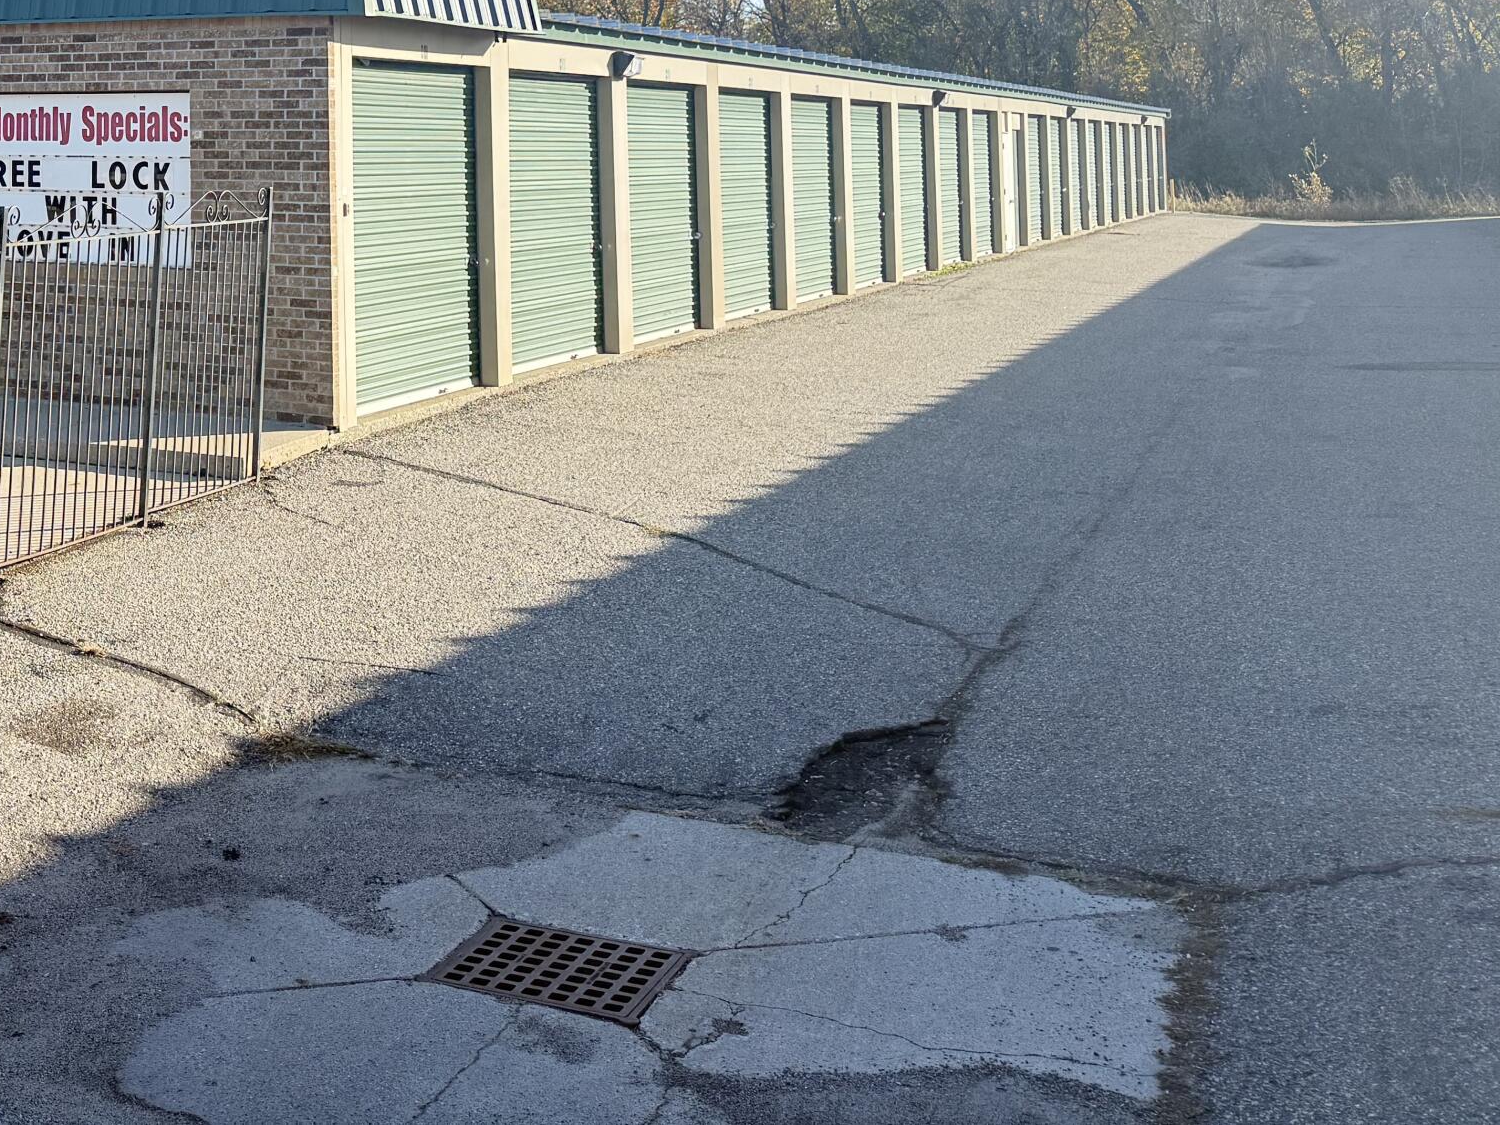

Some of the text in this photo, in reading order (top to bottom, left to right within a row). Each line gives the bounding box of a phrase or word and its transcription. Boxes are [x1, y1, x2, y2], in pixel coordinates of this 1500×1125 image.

[81, 105, 189, 146] Specials:
[91, 160, 171, 191] LOCK
[44, 195, 117, 225] WITH
[109, 232, 135, 262] IN
